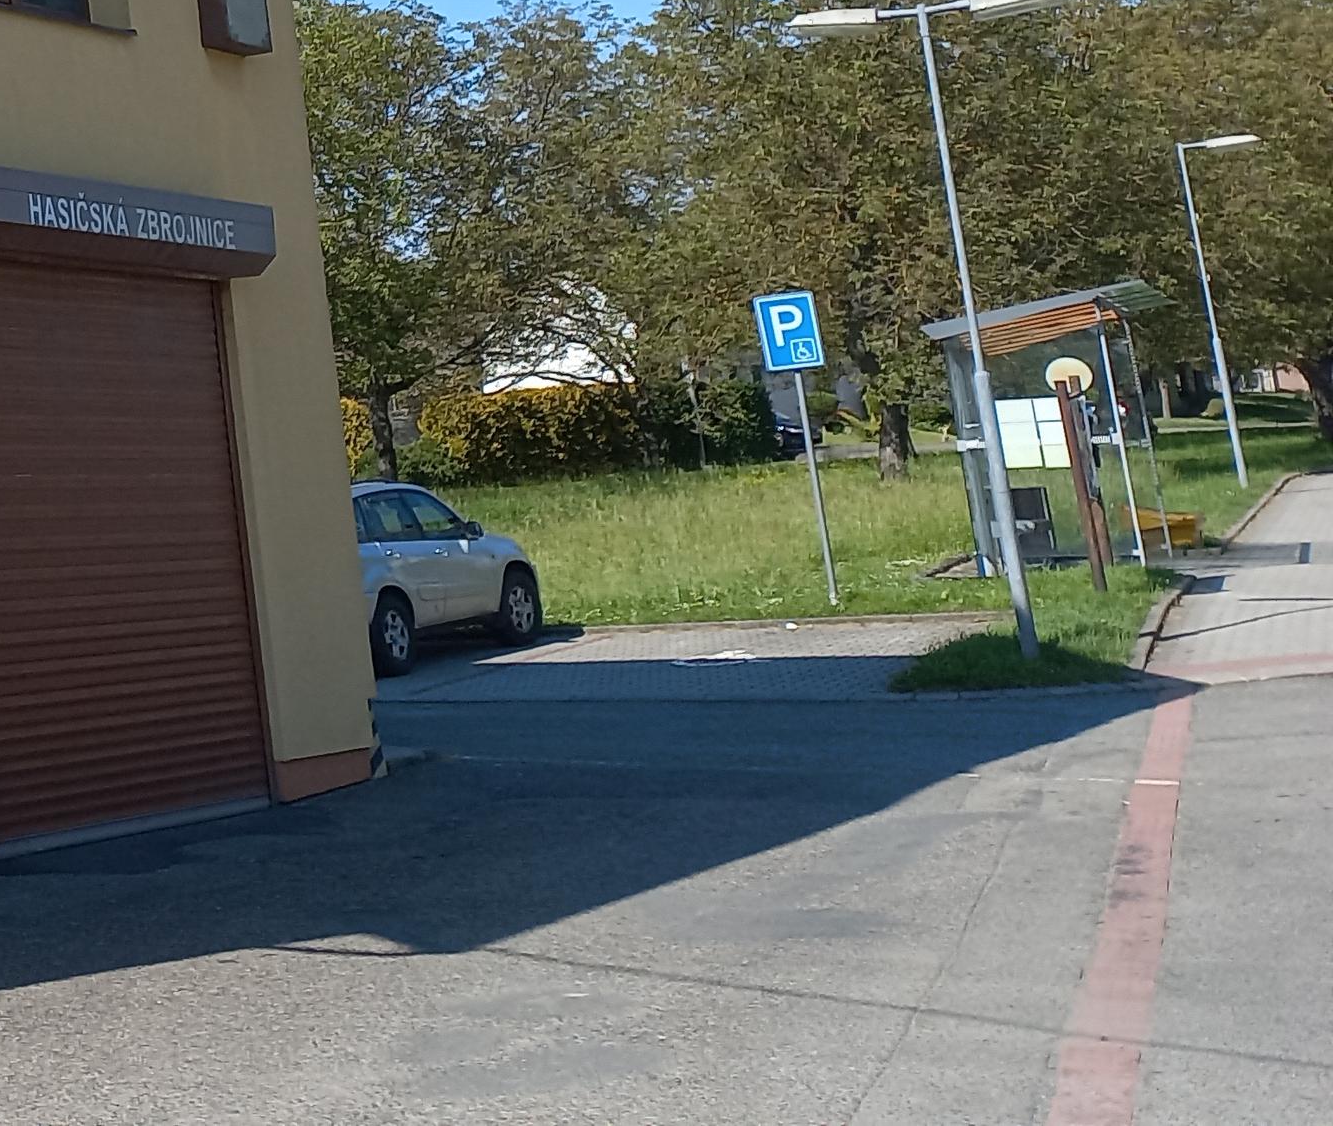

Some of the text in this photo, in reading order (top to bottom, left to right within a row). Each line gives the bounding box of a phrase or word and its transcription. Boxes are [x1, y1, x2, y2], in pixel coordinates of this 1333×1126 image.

[28, 191, 237, 250] HASIČSKÁ ZBROJNICE
[768, 304, 803, 347] P
